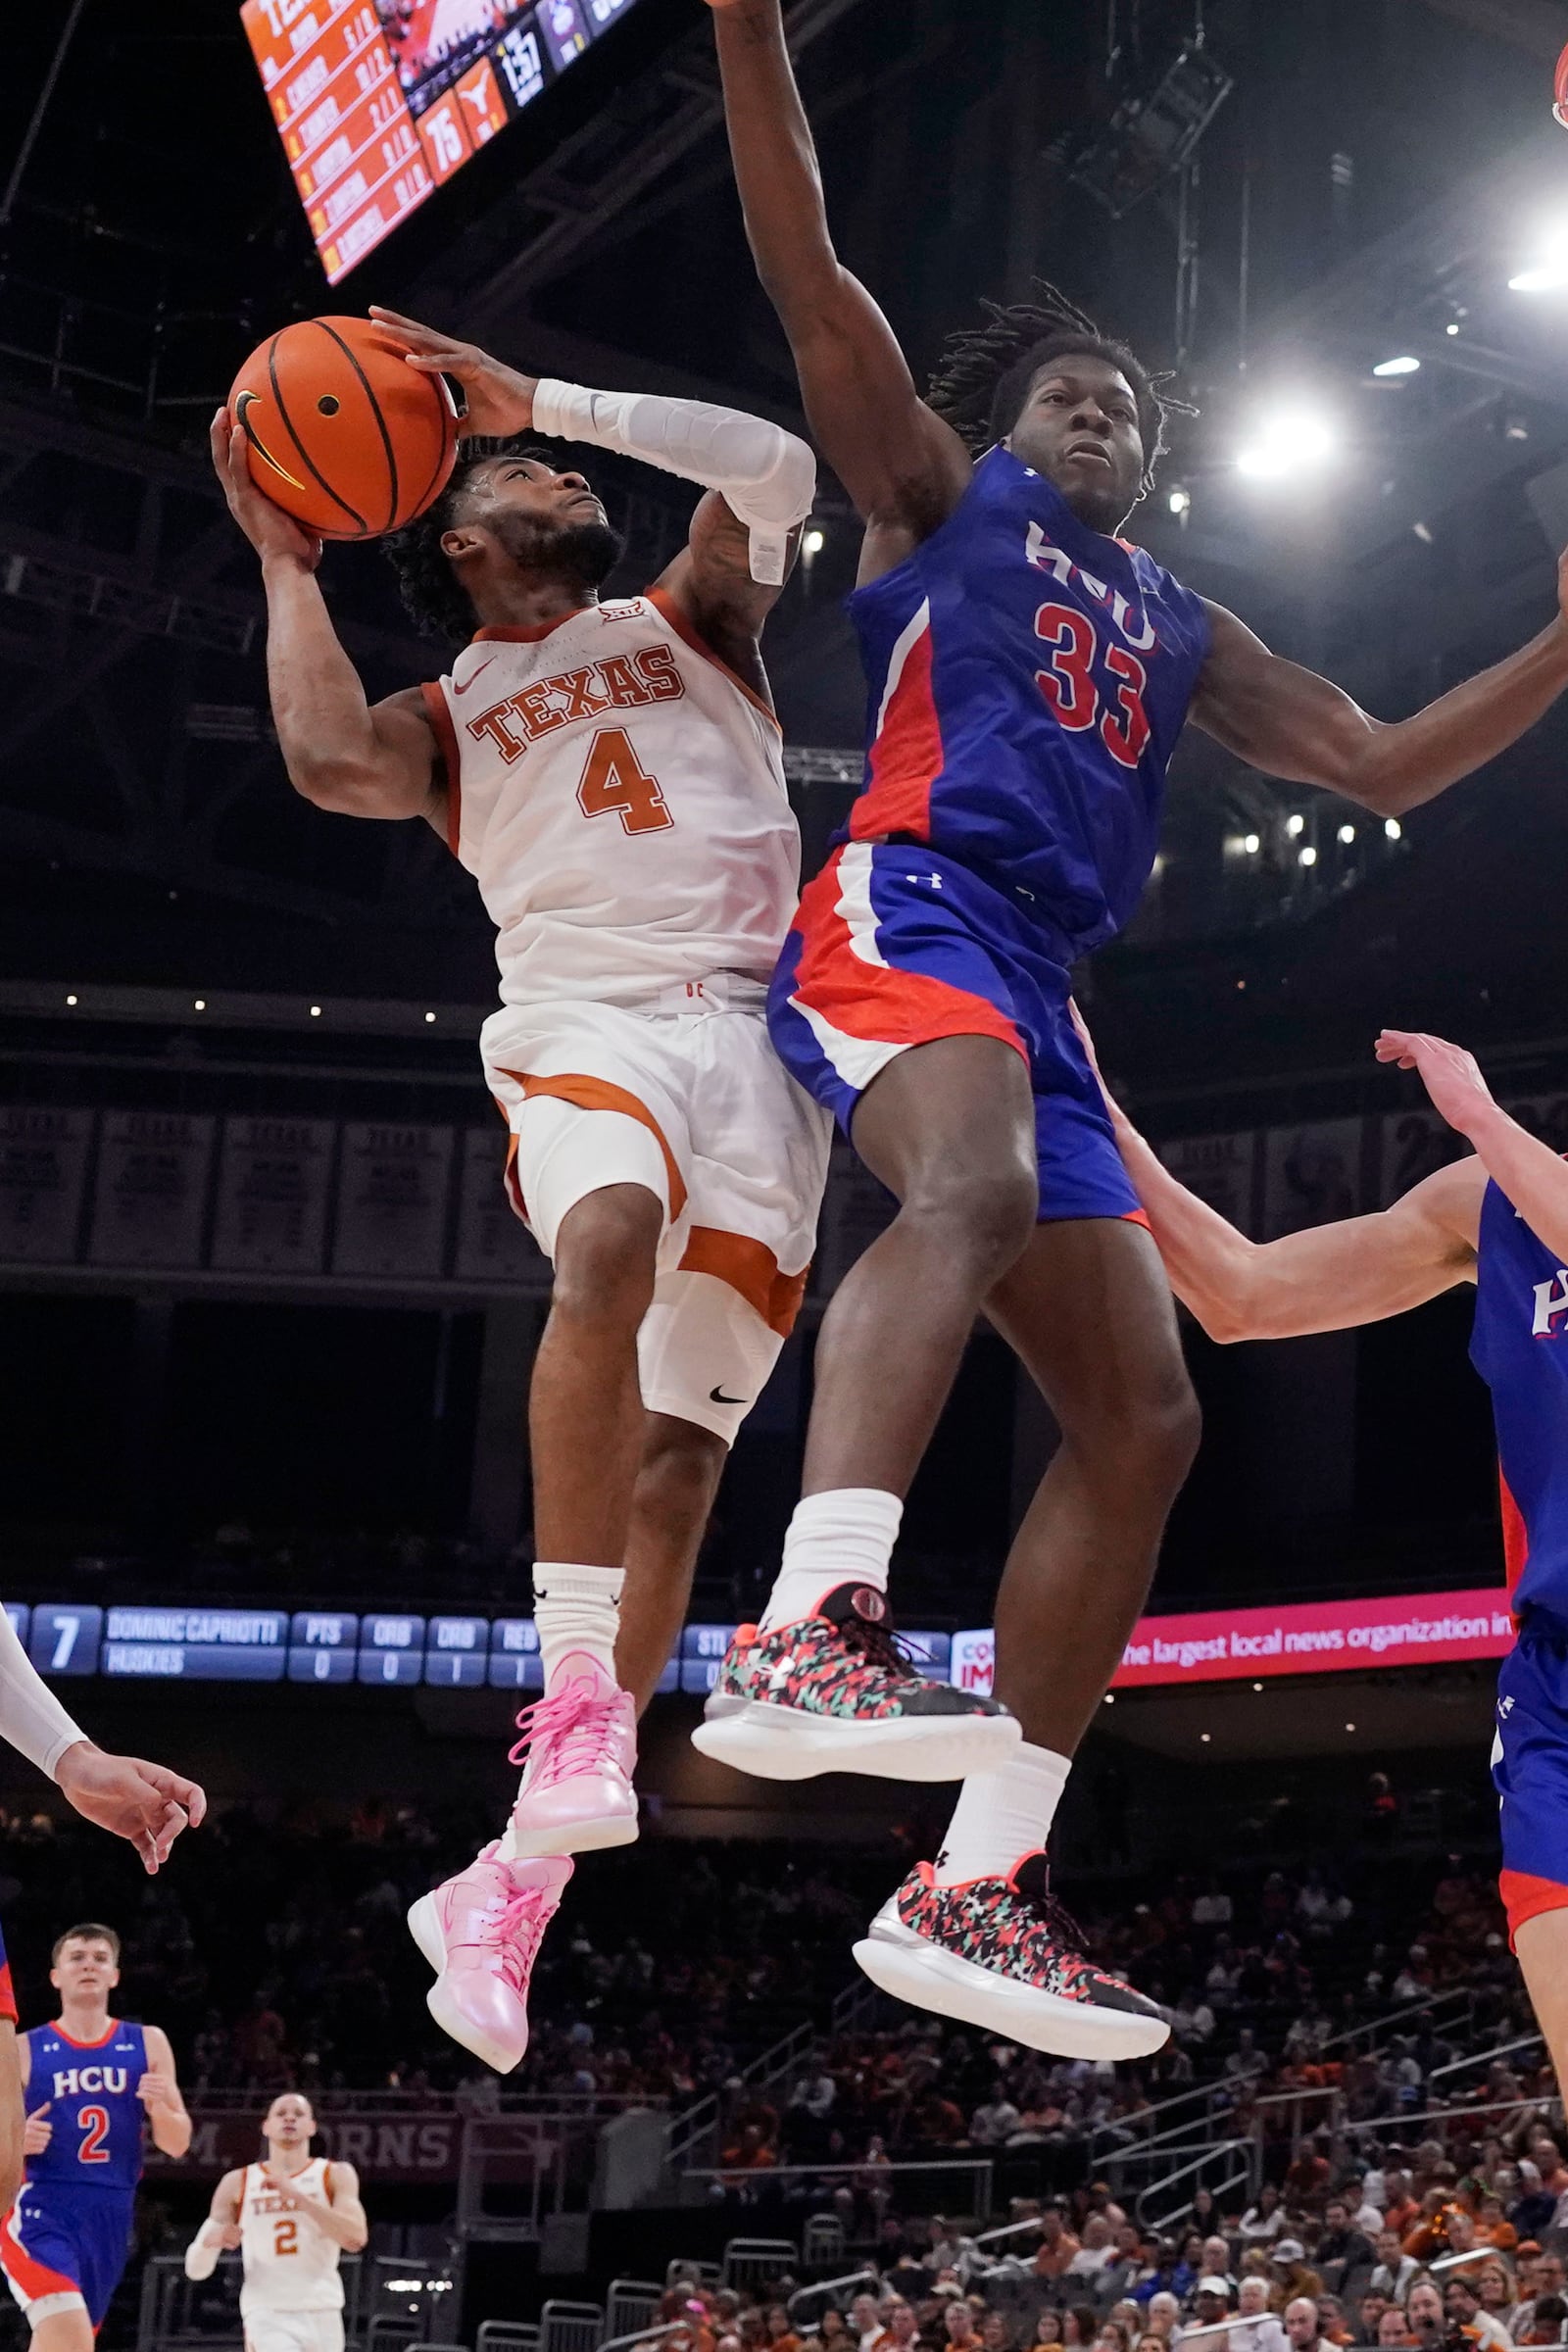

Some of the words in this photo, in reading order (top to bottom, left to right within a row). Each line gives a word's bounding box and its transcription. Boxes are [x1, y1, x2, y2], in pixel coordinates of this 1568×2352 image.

[425, 106, 463, 172] 75
[466, 643, 686, 765] TEXAS
[1034, 602, 1152, 769] 33
[575, 727, 675, 836] 4
[51, 1616, 80, 1669] 7
[306, 1617, 342, 1644] PTS
[1153, 1638, 1227, 1668] largest
[1231, 1628, 1282, 1657] local
[1284, 1629, 1345, 1653] news
[1347, 1615, 1489, 1652] organization
[314, 1650, 330, 1679] 0
[383, 1653, 399, 1681] 0
[53, 2066, 128, 2099] HCU
[76, 2104, 111, 2164] 2
[274, 2220, 298, 2257] 2
